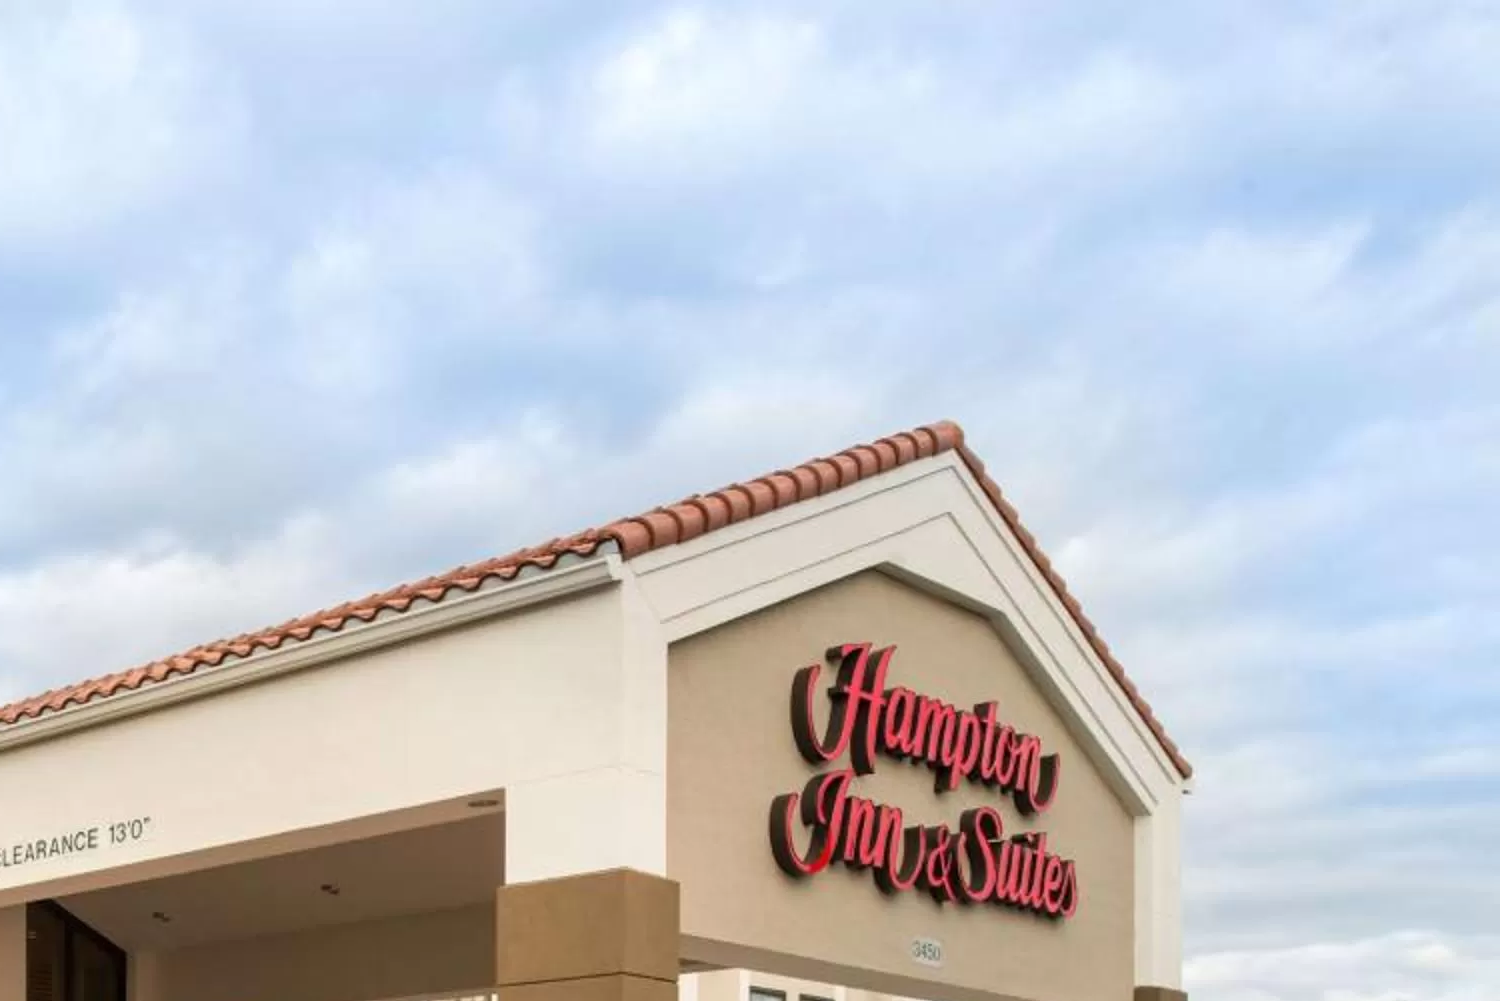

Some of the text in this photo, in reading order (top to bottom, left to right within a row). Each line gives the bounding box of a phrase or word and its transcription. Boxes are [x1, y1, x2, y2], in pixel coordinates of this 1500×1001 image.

[791, 642, 1060, 815] Hampton
[769, 769, 1078, 919] Inn & Suites
[911, 940, 941, 961] 3450
